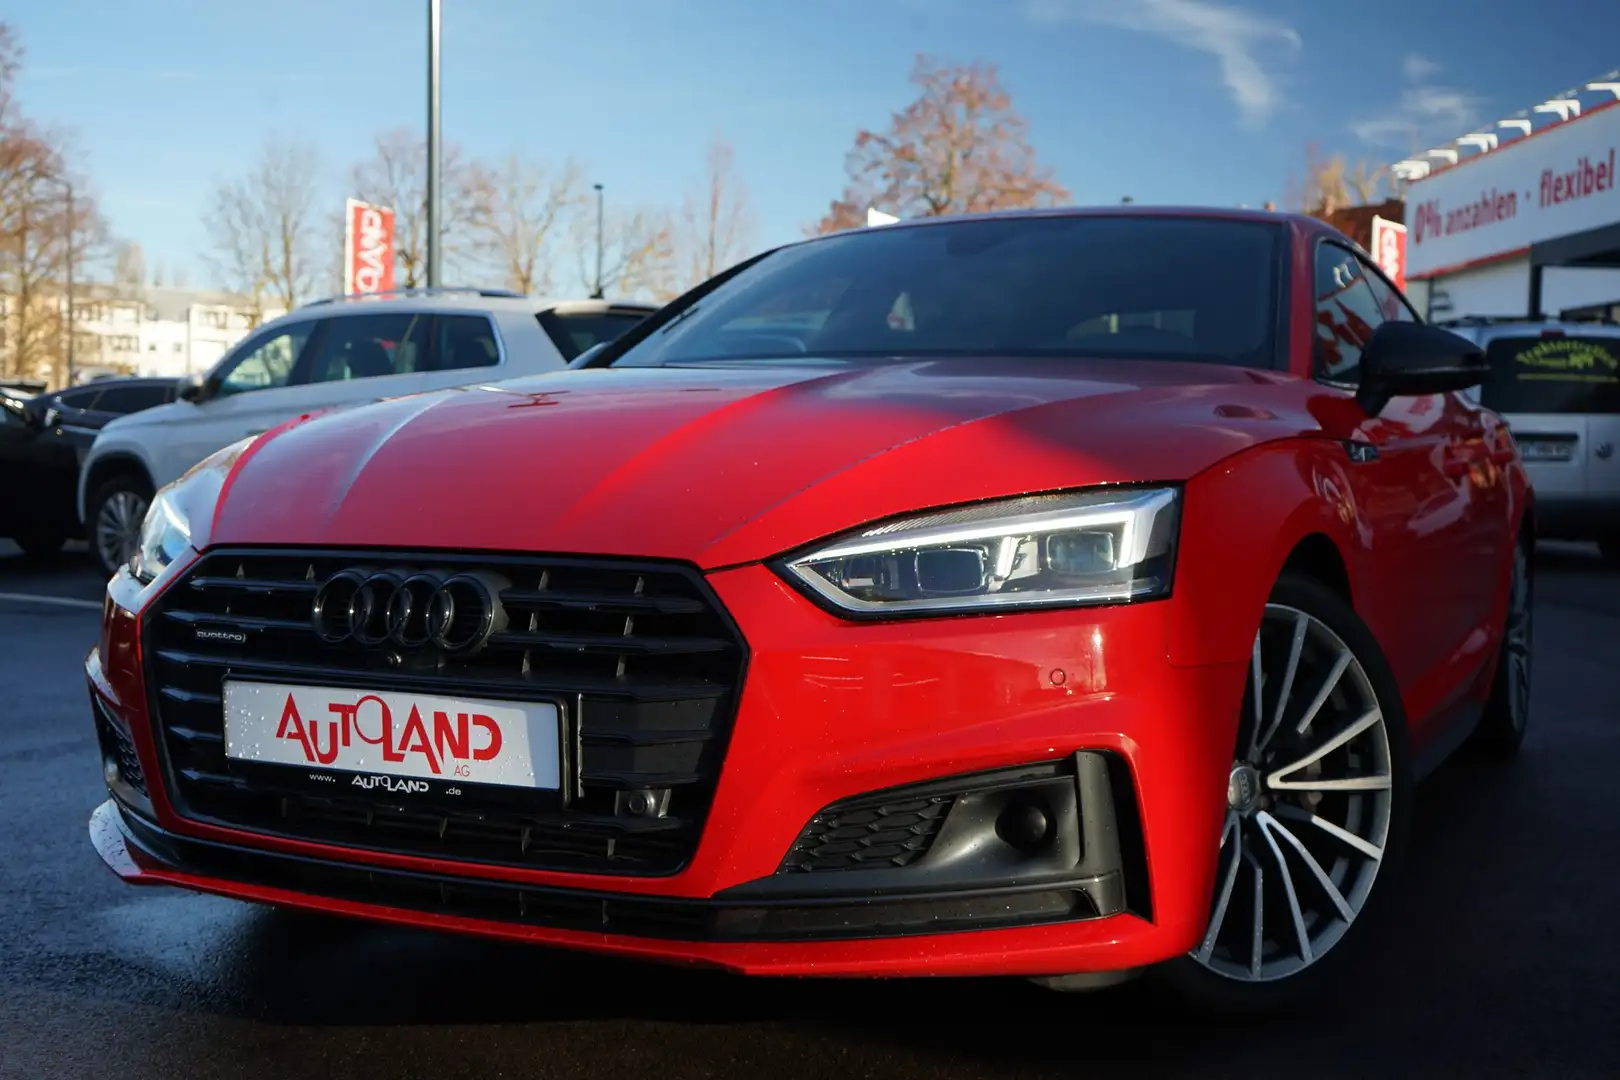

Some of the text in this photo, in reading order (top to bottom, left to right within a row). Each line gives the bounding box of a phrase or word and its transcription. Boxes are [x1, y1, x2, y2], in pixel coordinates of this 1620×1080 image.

[1445, 187, 1517, 236] anzahlen
[1539, 147, 1615, 209] flexibel
[196, 630, 245, 641] quattro
[276, 692, 503, 774] AUTOLAND
[453, 765, 471, 777] AG
[309, 772, 462, 796] www. AUTOLAND .de
